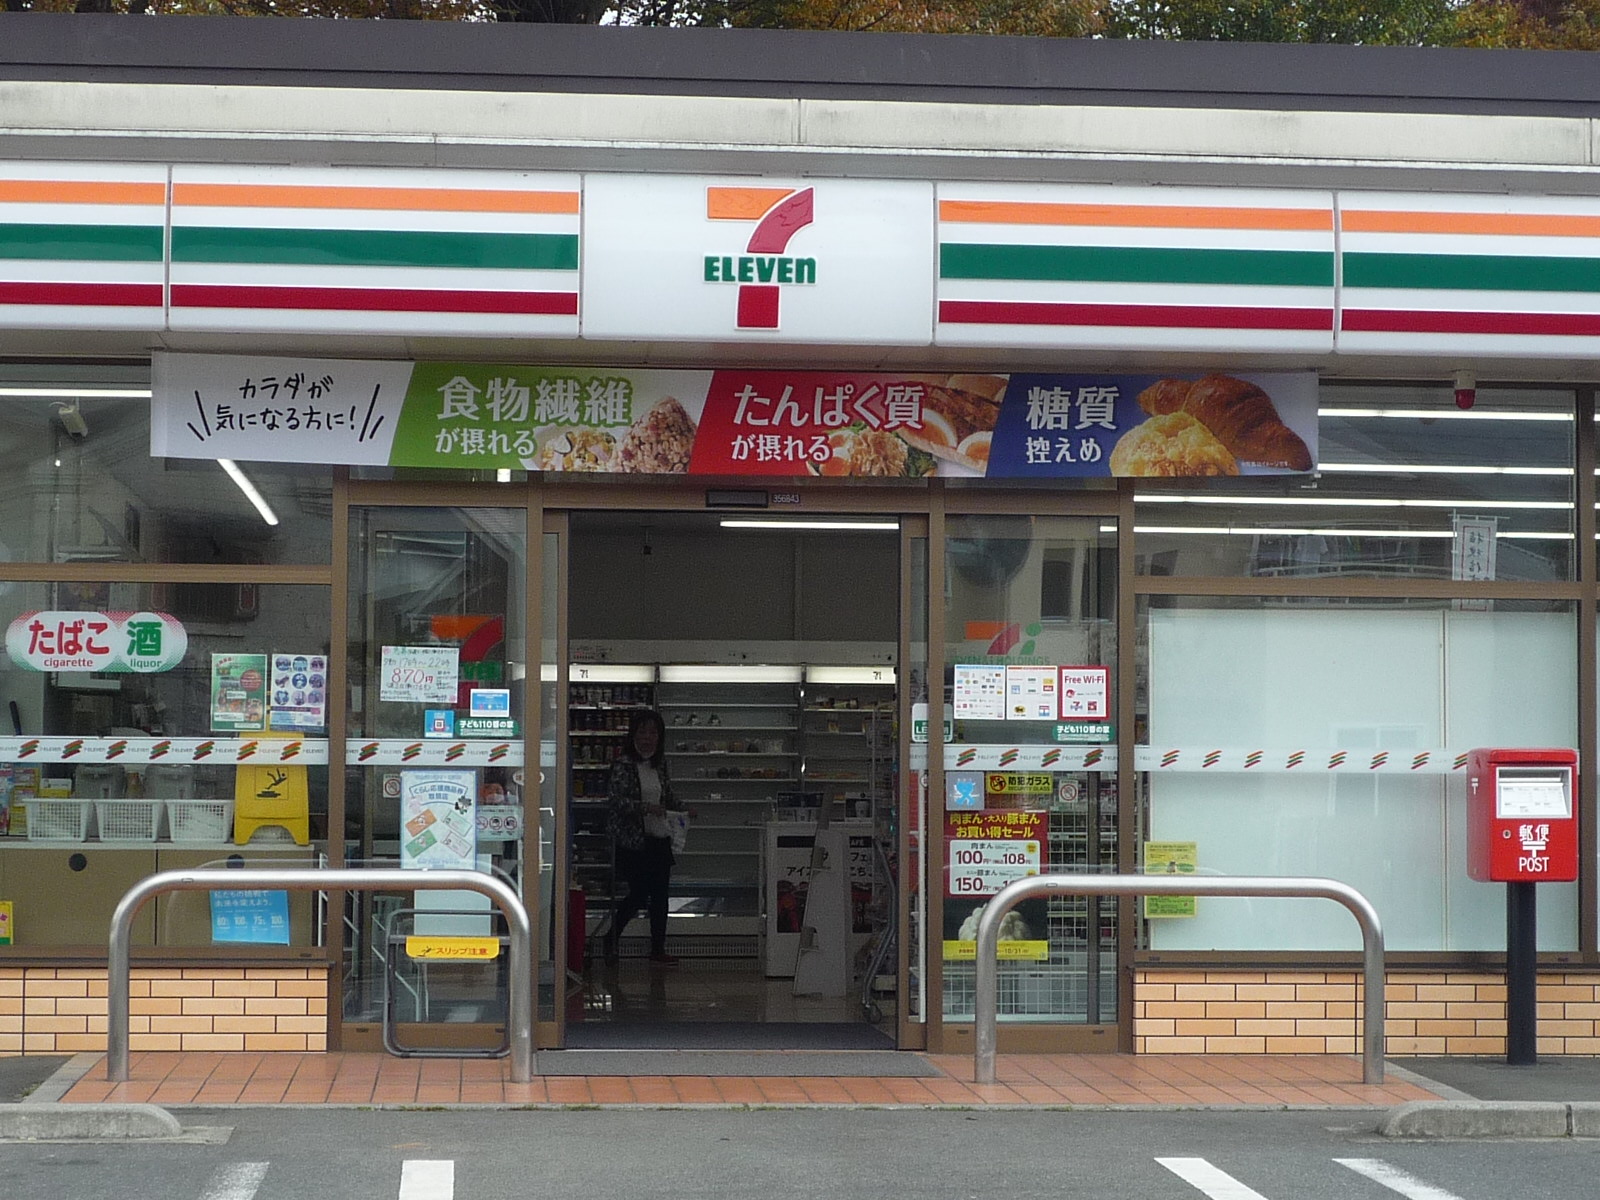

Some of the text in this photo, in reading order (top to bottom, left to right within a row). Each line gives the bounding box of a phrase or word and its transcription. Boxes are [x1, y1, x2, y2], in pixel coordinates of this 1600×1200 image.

[238, 373, 334, 399] カラダが
[435, 374, 632, 425] 食物繊維
[731, 383, 925, 430] たんぱく質
[1025, 386, 1120, 431] 糖質
[434, 427, 535, 456] が摂れる
[730, 434, 833, 462] が摂れる
[1025, 437, 1102, 464] 控えめ
[28, 619, 110, 656] たばこ
[126, 621, 163, 656] 酒
[44, 658, 94, 669] cigarette
[130, 659, 162, 669] liquor
[1064, 675, 1104, 684] Free Wi-Fi
[1008, 776, 1050, 786] 防犯ガラス
[956, 826, 1034, 838] お買い得セール
[1519, 824, 1549, 842] 郵便
[971, 842, 994, 850] 肉まん
[1519, 856, 1549, 872] POST
[436, 947, 488, 956] スリップ注意
